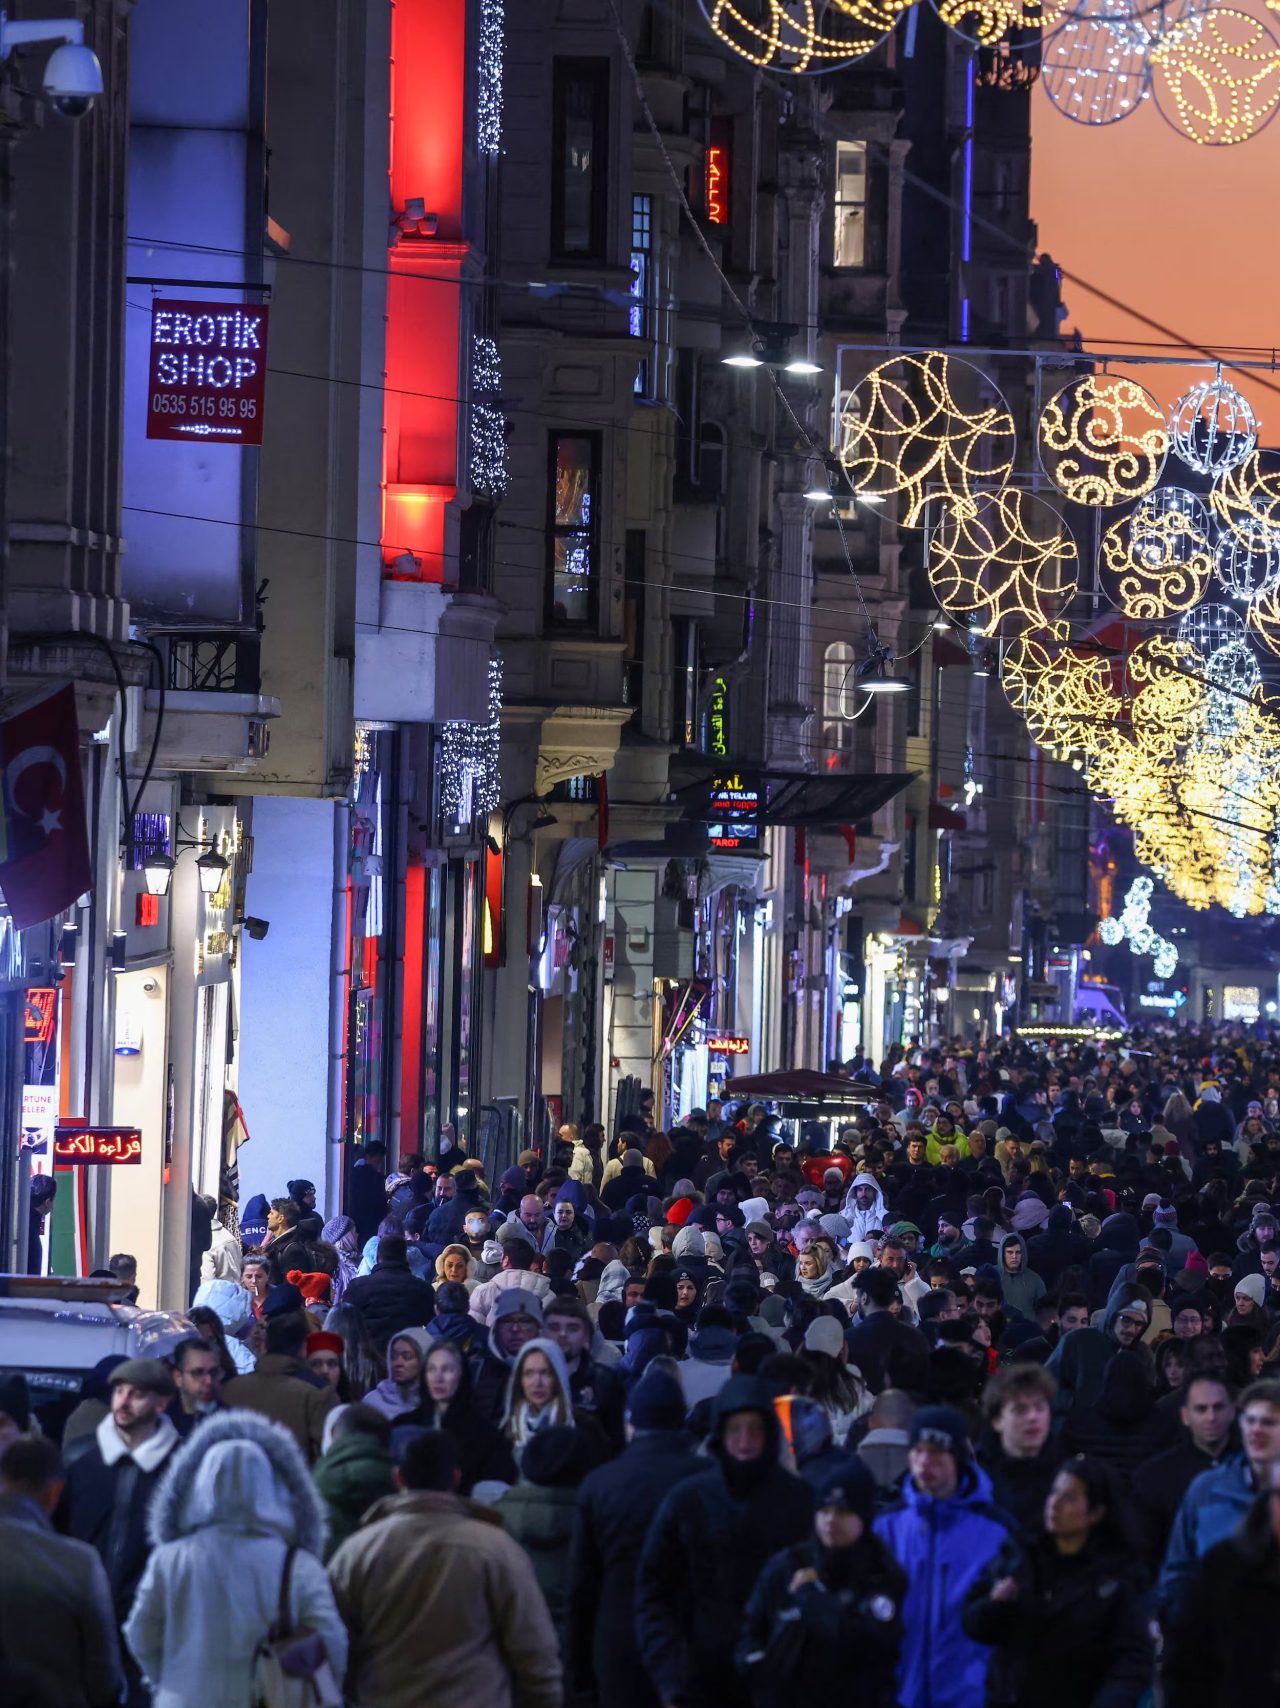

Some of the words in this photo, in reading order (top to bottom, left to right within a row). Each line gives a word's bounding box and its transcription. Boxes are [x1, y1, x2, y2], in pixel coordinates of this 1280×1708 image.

[154, 311, 261, 348] EROTİK
[157, 353, 257, 389] SHOP
[152, 393, 187, 414] 0535
[190, 395, 216, 417] 515
[219, 397, 236, 417] 95
[240, 398, 257, 419] 95
[711, 838, 740, 847] TAROT
[23, 1095, 52, 1104] RTUNE
[22, 1106, 45, 1114] ELLER
[240, 1226, 267, 1235] LENC
